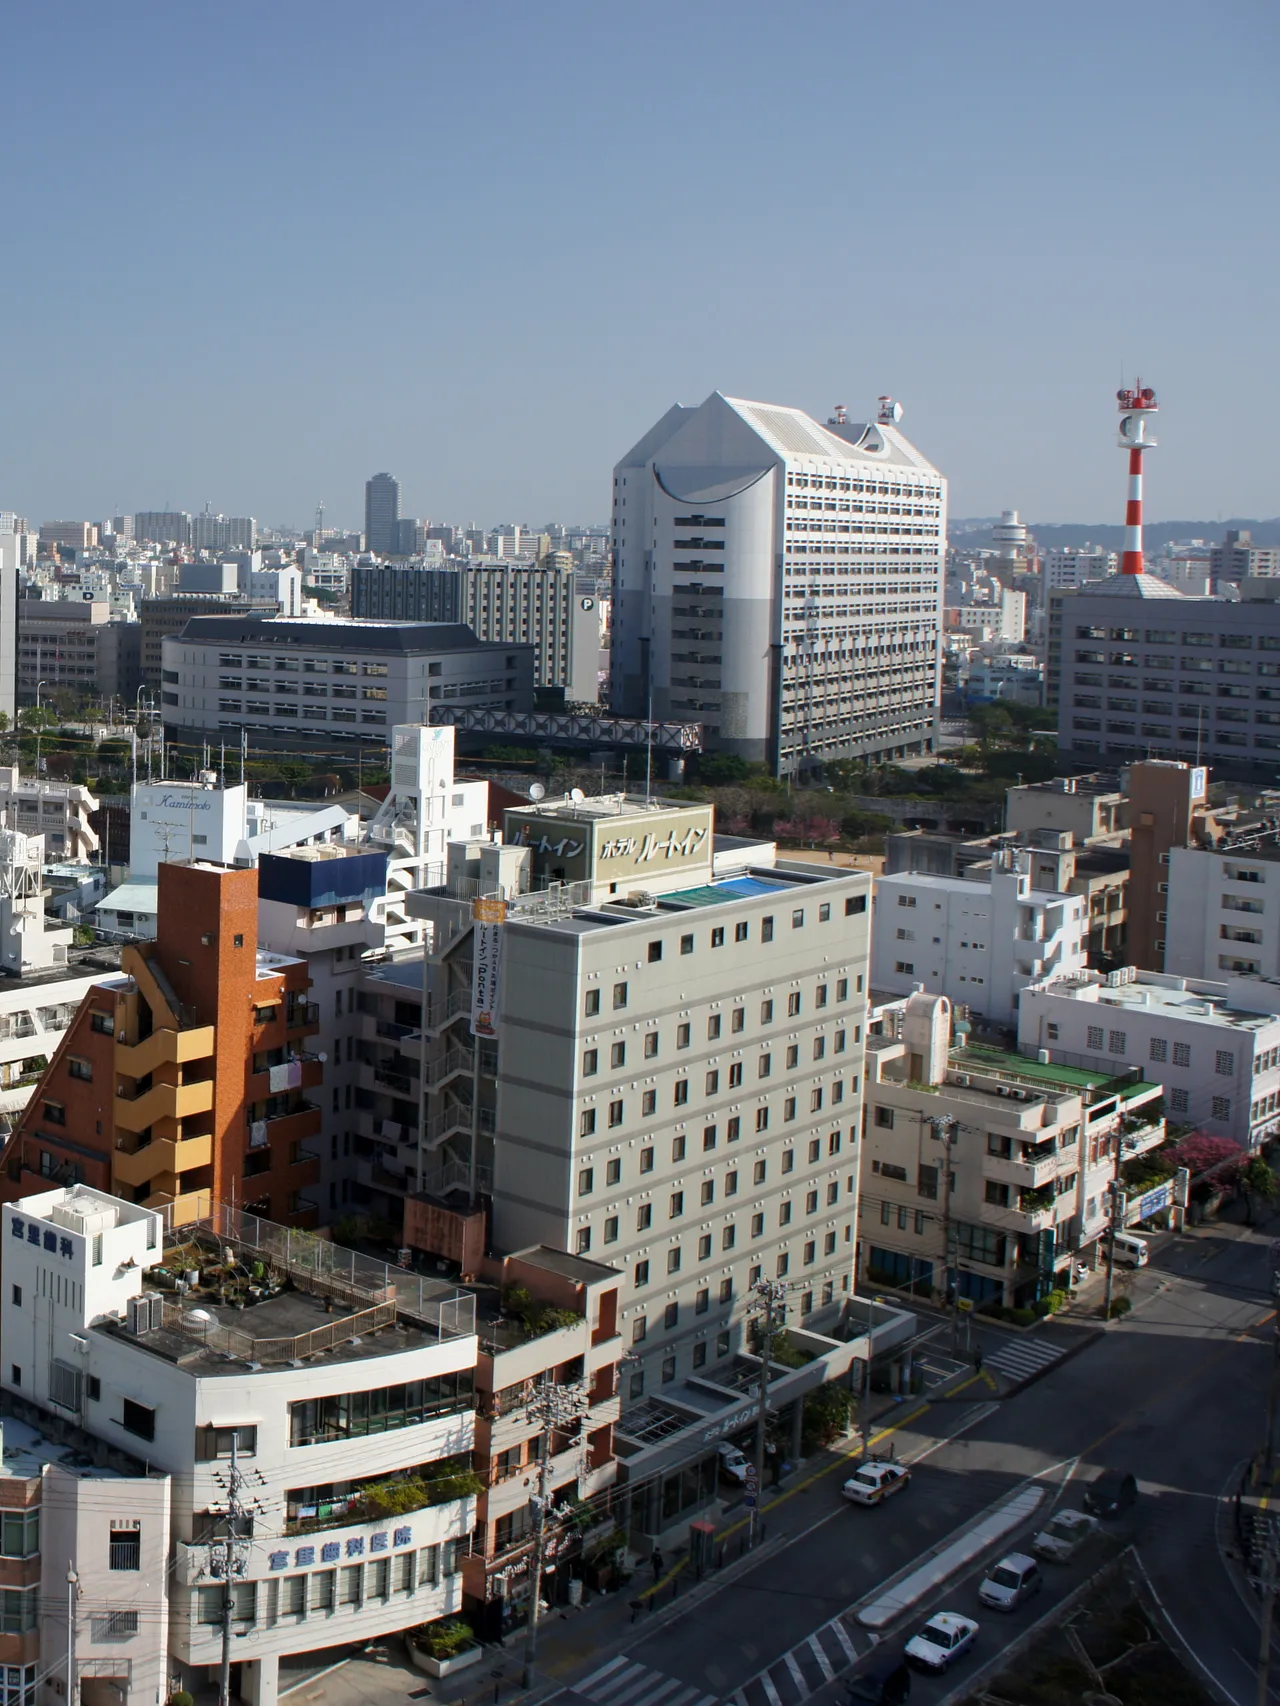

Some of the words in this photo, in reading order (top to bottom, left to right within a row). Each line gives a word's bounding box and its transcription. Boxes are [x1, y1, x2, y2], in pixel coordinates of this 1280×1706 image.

[583, 599, 592, 610] P
[155, 794, 211, 811] Kamimoto
[600, 836, 637, 860] ホテル
[635, 827, 709, 864] ルートイン
[268, 1525, 413, 1572] 宮里歯科医院
